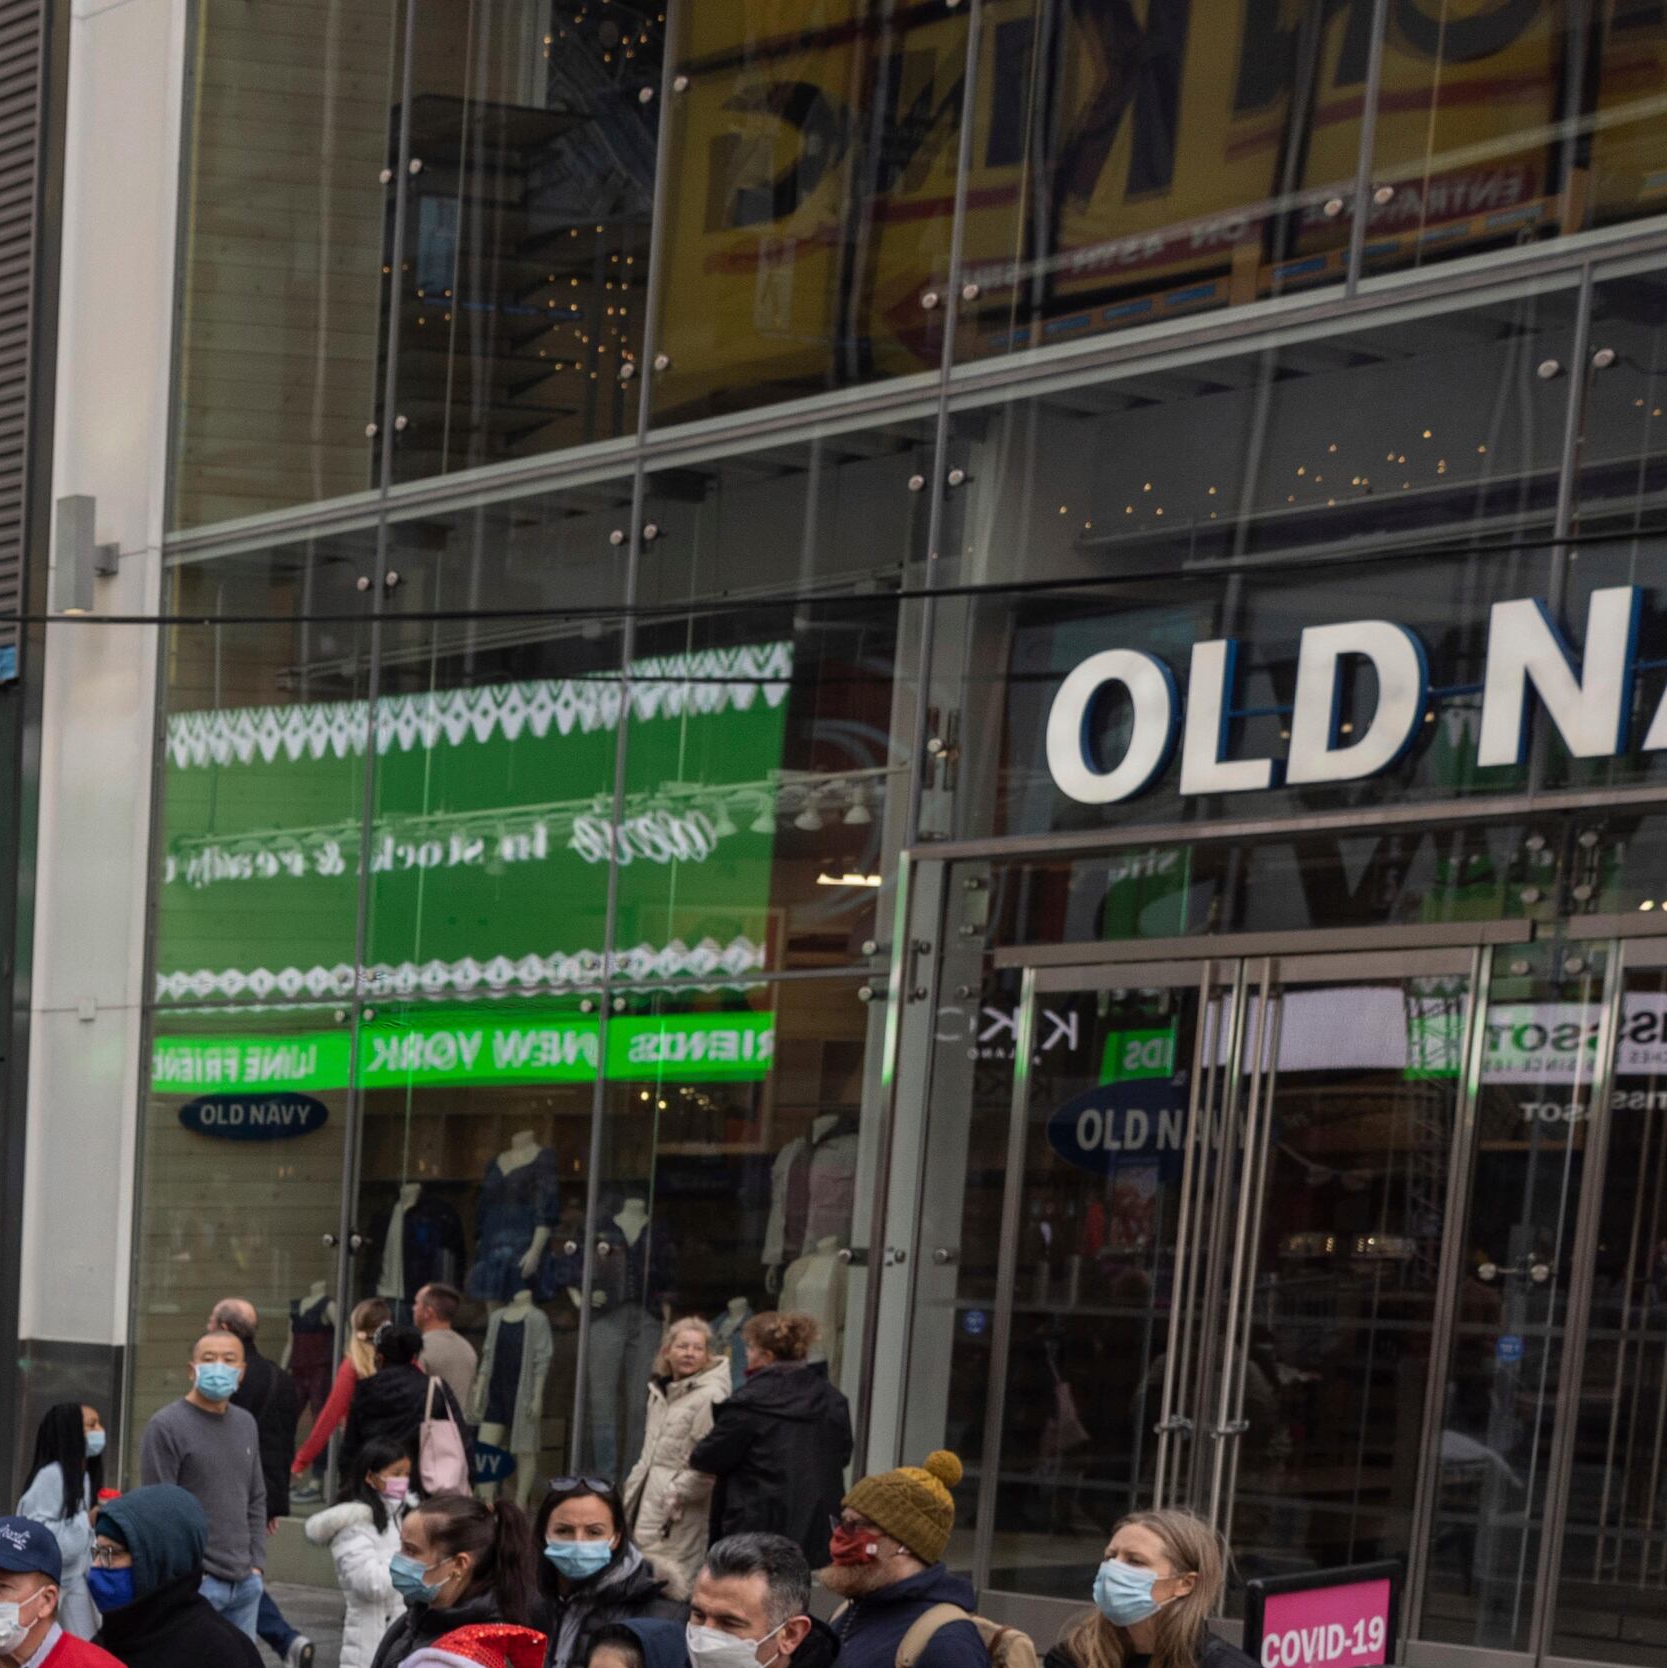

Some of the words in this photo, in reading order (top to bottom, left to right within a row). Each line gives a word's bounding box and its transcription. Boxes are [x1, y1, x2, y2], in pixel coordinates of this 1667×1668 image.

[1046, 620, 1432, 806] OLD
[1477, 585, 1667, 768] N
[200, 1103, 244, 1126] OLD
[250, 1103, 311, 1126] NAVY
[1076, 1108, 1151, 1152] OLD
